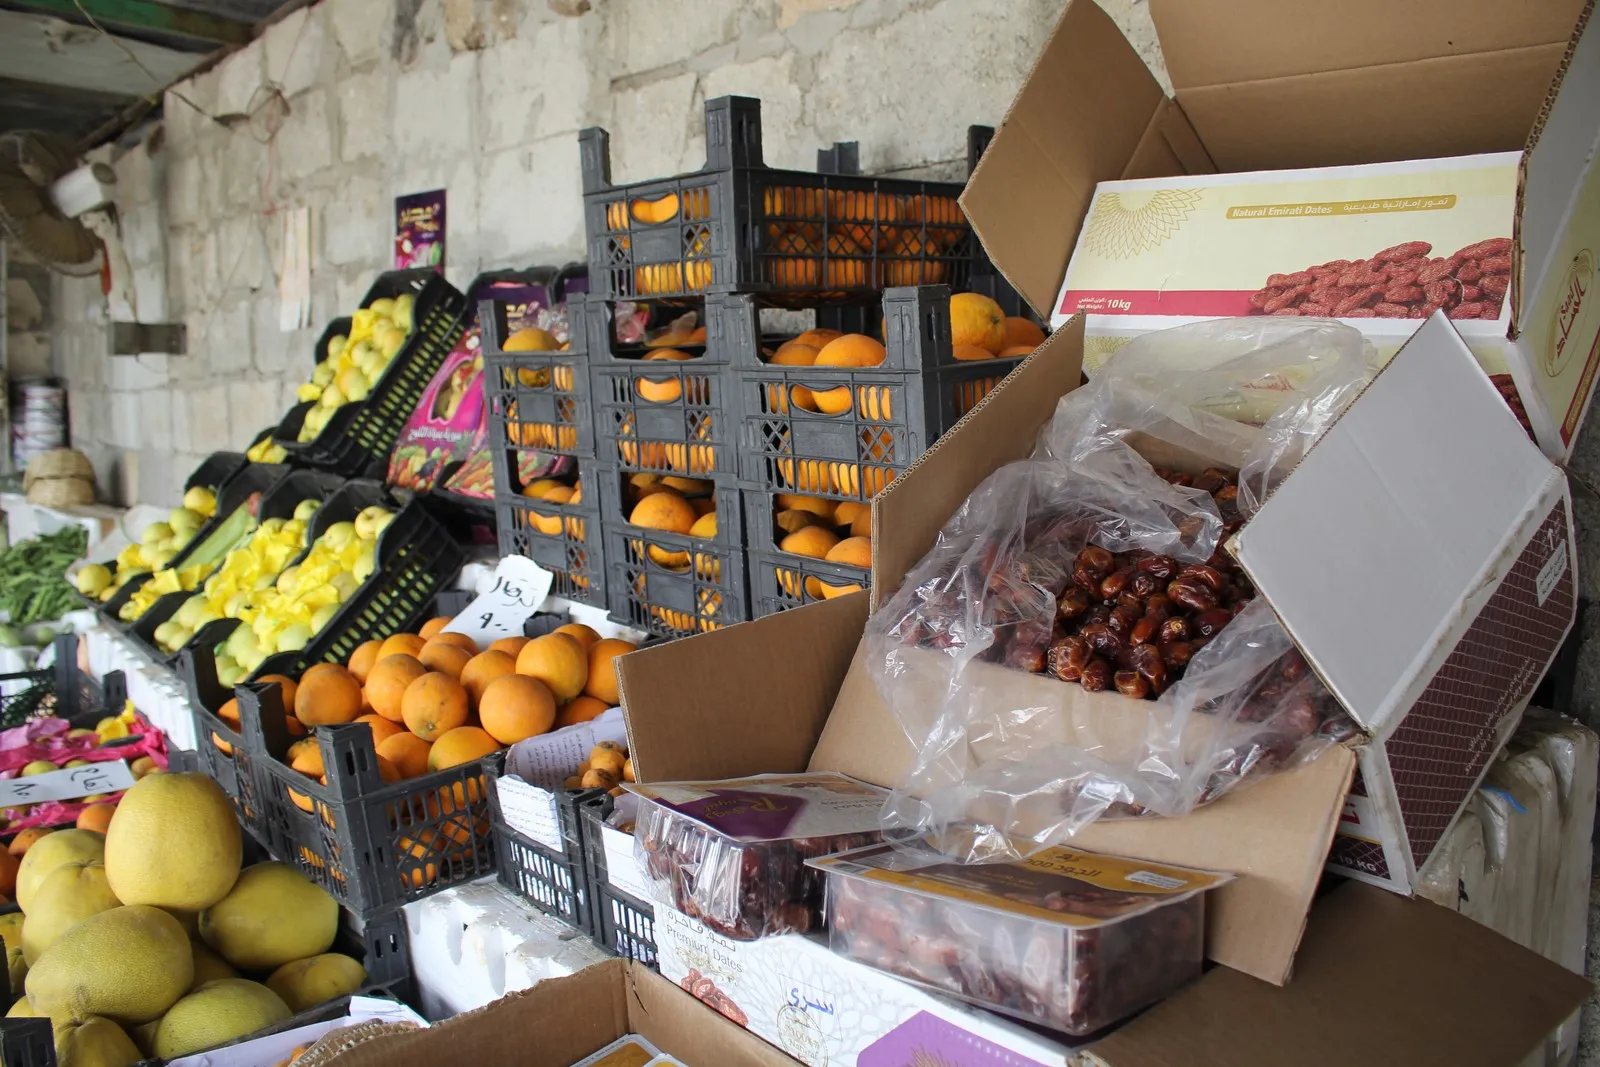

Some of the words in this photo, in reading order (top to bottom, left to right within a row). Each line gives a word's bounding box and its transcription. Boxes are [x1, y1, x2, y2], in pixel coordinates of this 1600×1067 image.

[1343, 202, 1380, 213] طبيعية
[1382, 199, 1421, 210] إماراتية
[1423, 197, 1449, 208] تمور
[1232, 208, 1266, 217] Natural
[1268, 206, 1303, 215] Emirati
[1304, 205, 1332, 214] Dates
[667, 924, 709, 954] Premium
[712, 948, 743, 973] Dates
